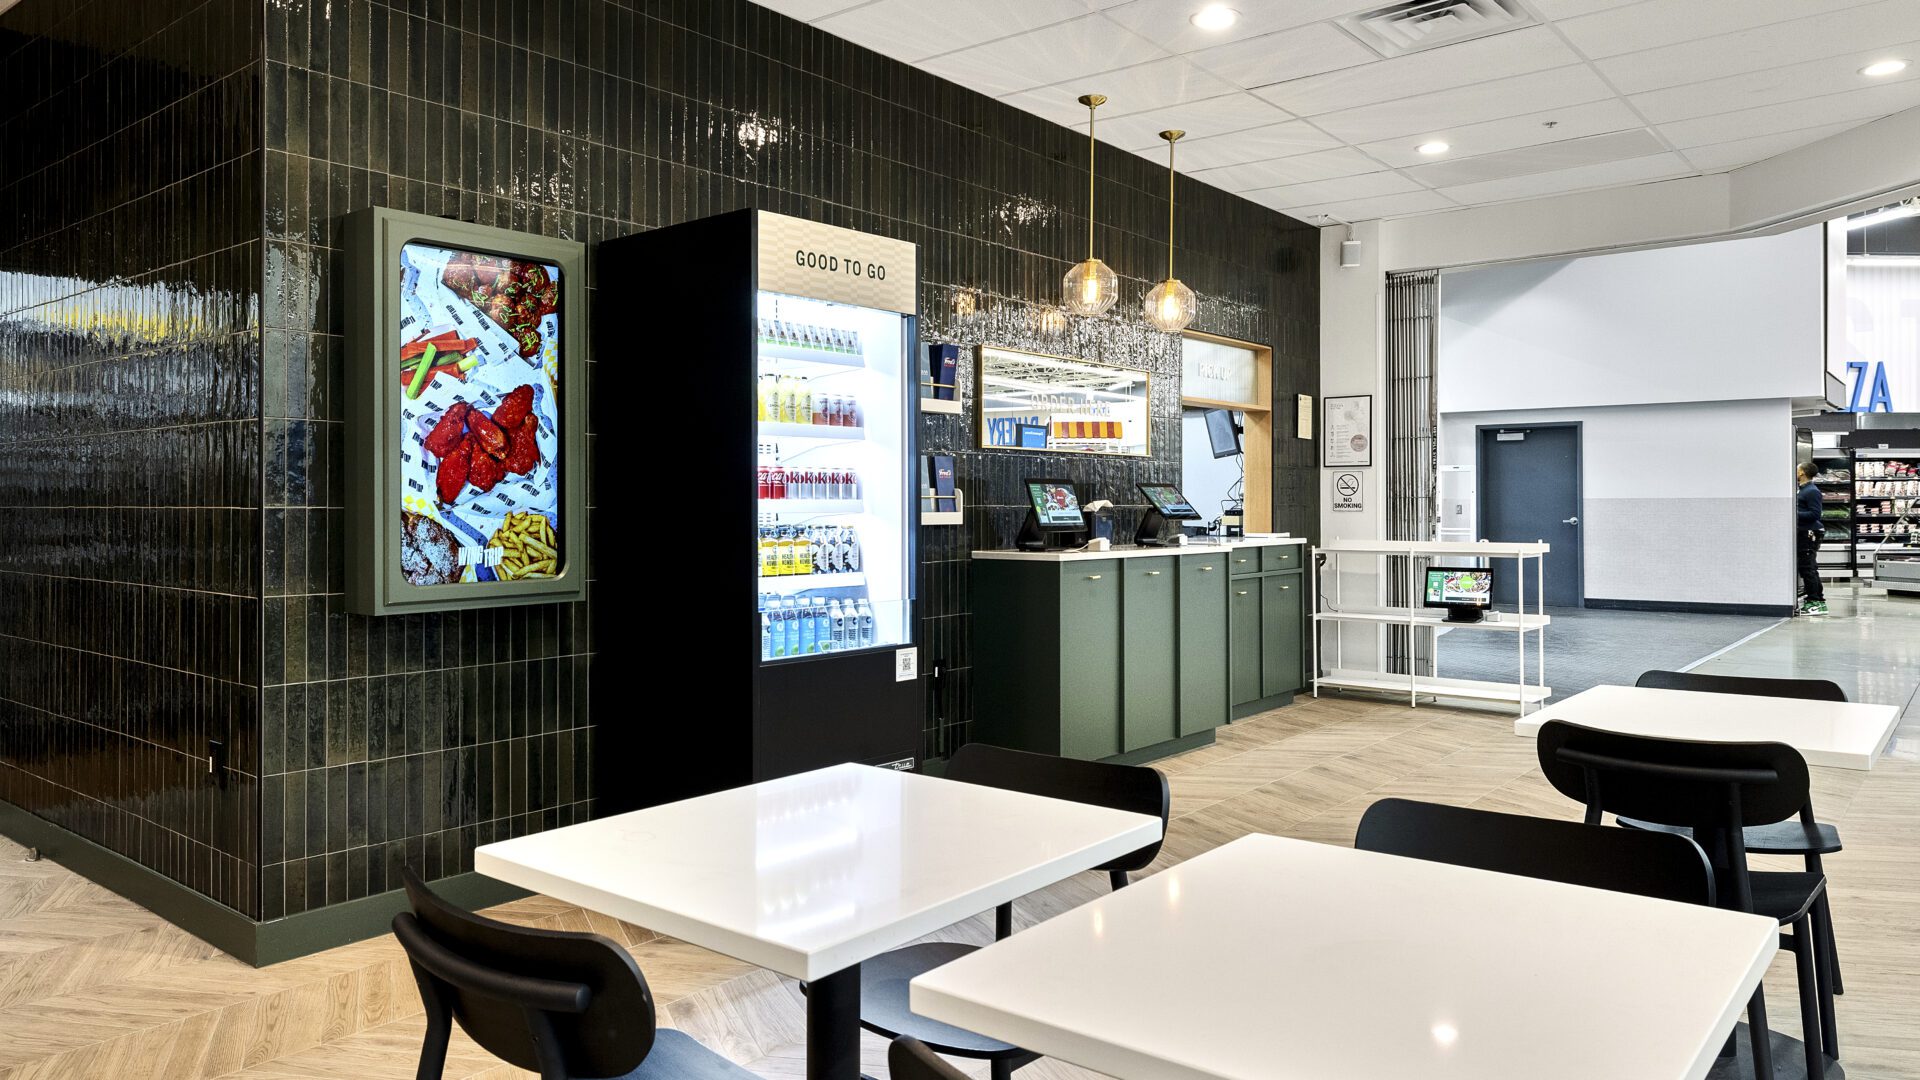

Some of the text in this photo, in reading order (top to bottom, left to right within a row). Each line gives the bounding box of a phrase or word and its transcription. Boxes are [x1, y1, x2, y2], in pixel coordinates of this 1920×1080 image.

[796, 250, 886, 281] GOOD TO GO
[1845, 361, 1893, 412] ZA
[1031, 393, 1075, 414] ORDER
[458, 546, 504, 568] WING TRIP
